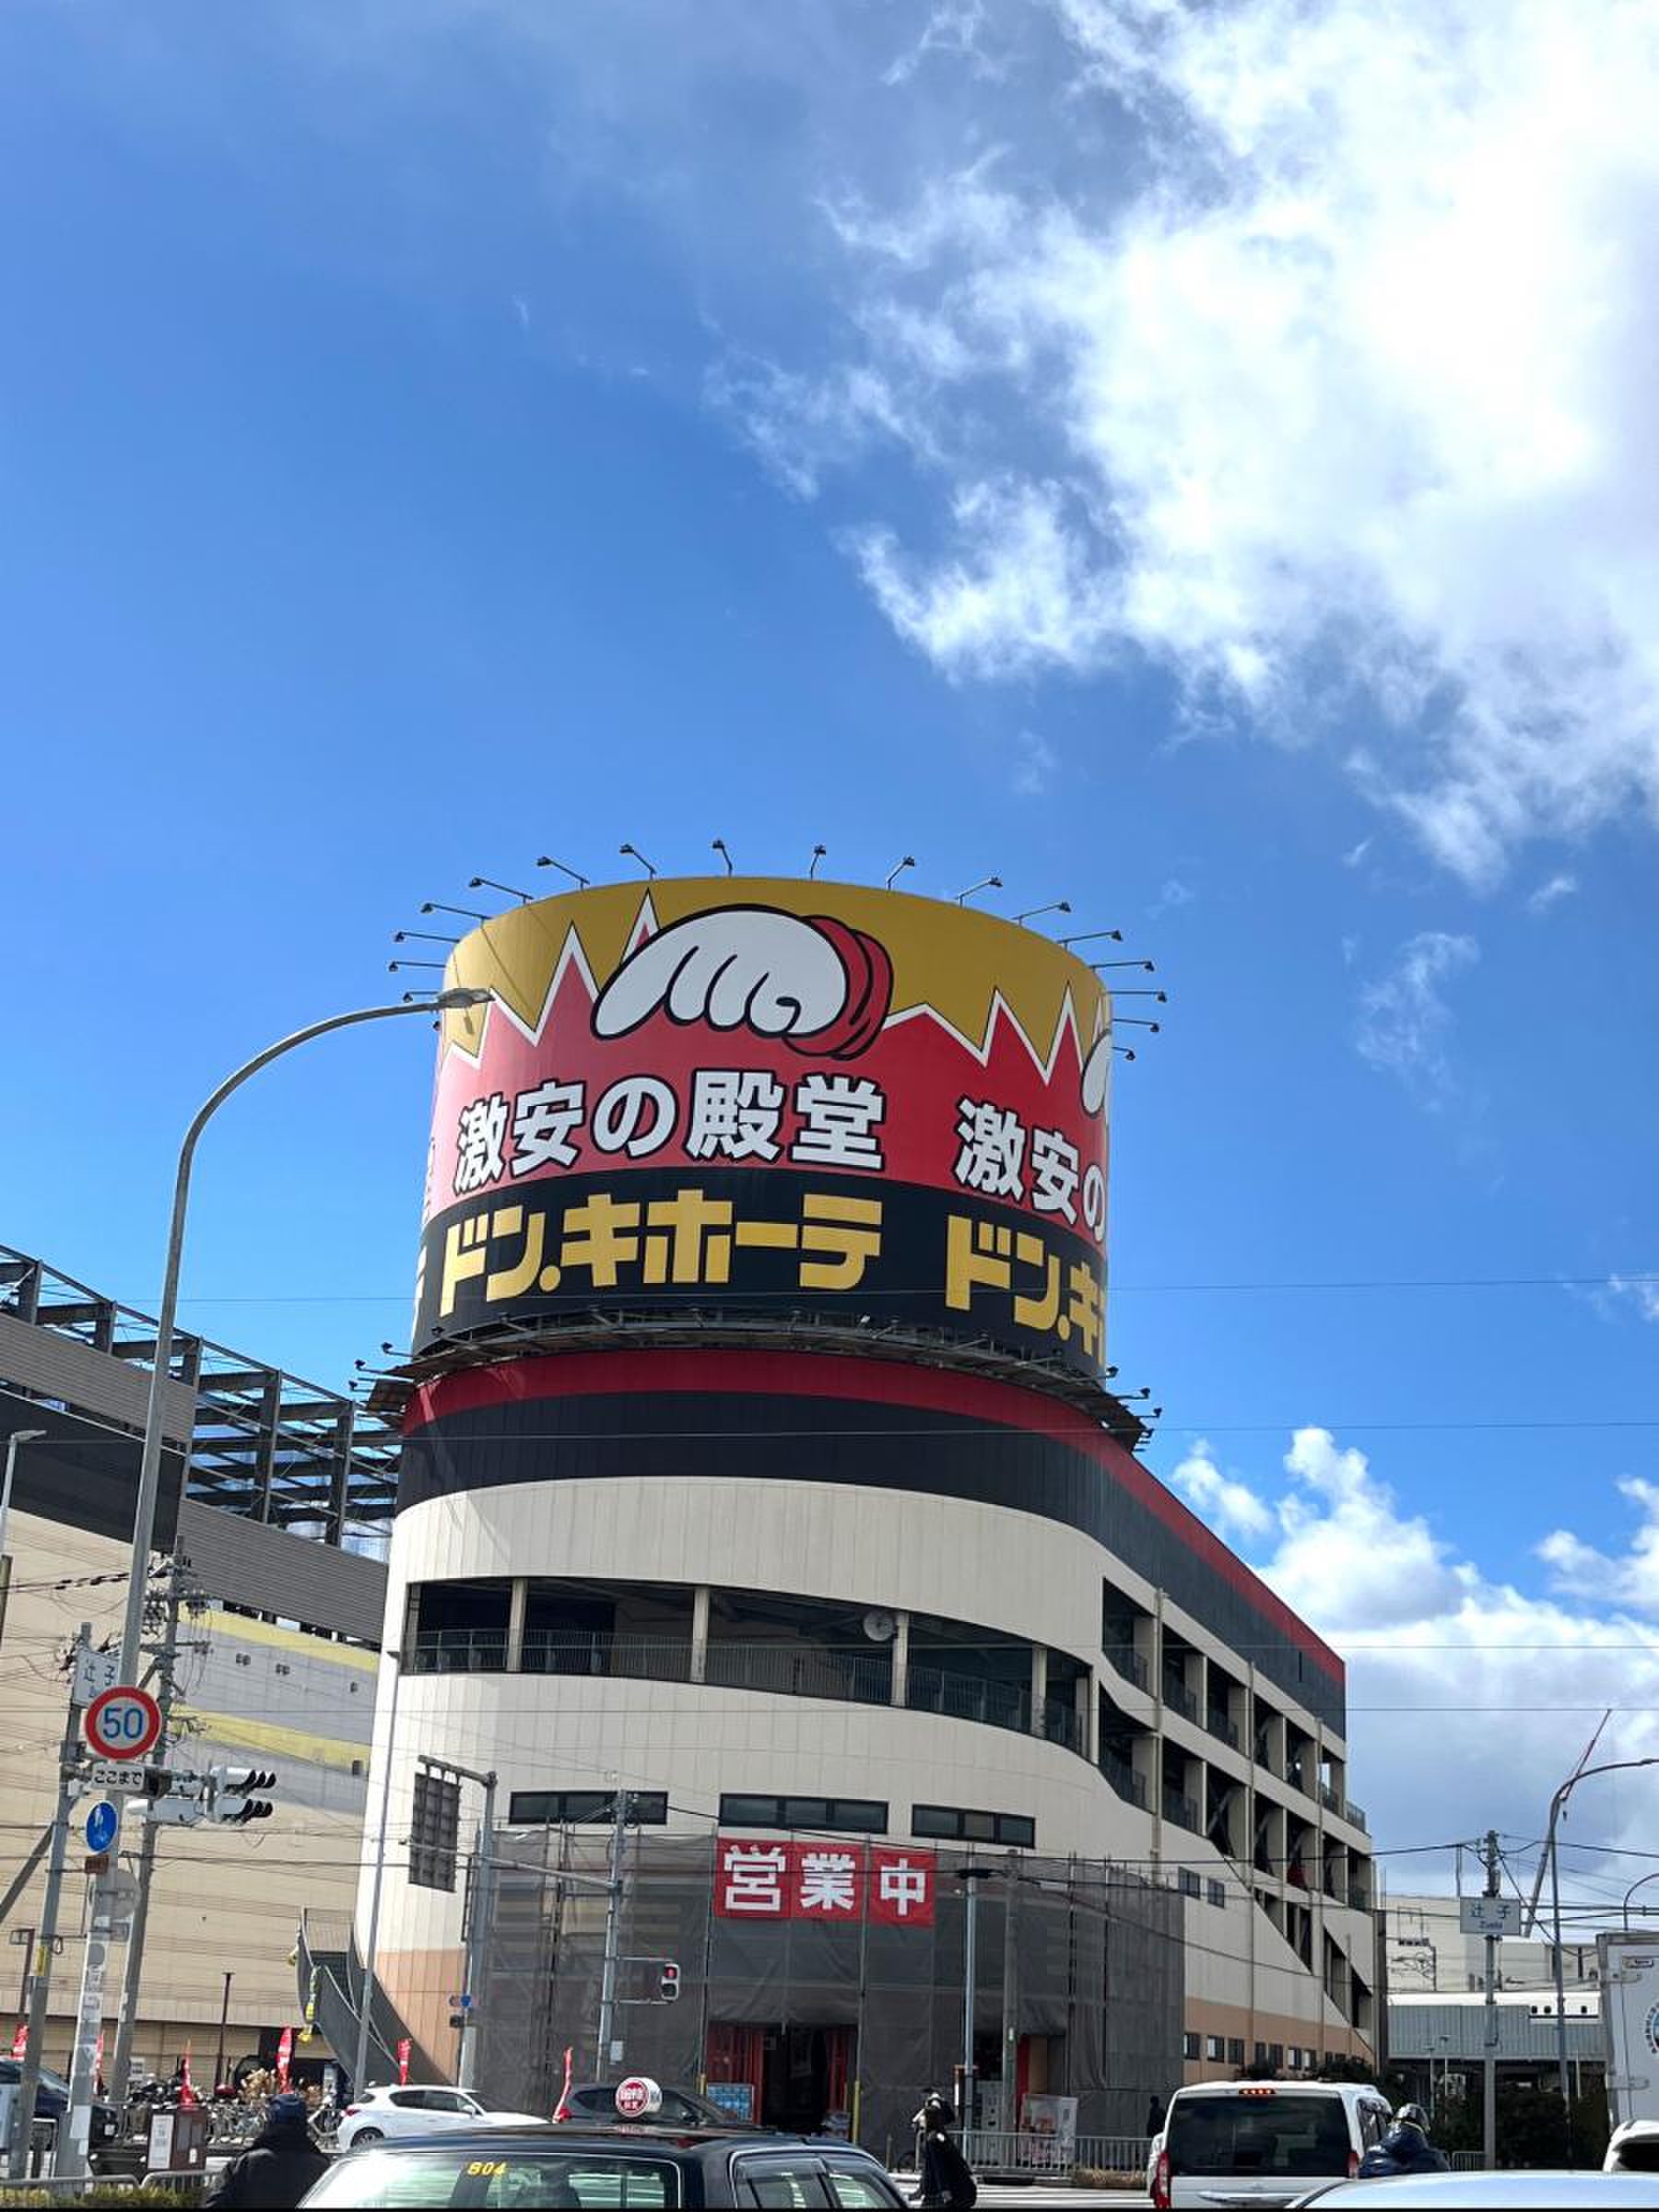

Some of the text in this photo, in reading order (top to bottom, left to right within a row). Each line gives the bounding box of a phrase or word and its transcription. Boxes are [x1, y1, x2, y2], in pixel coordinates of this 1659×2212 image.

[453, 1070, 885, 1194] 激安の殿堂
[102, 1707, 144, 1740] 50
[94, 1769, 143, 1786] ここまで
[723, 1844, 926, 1916] 営業中
